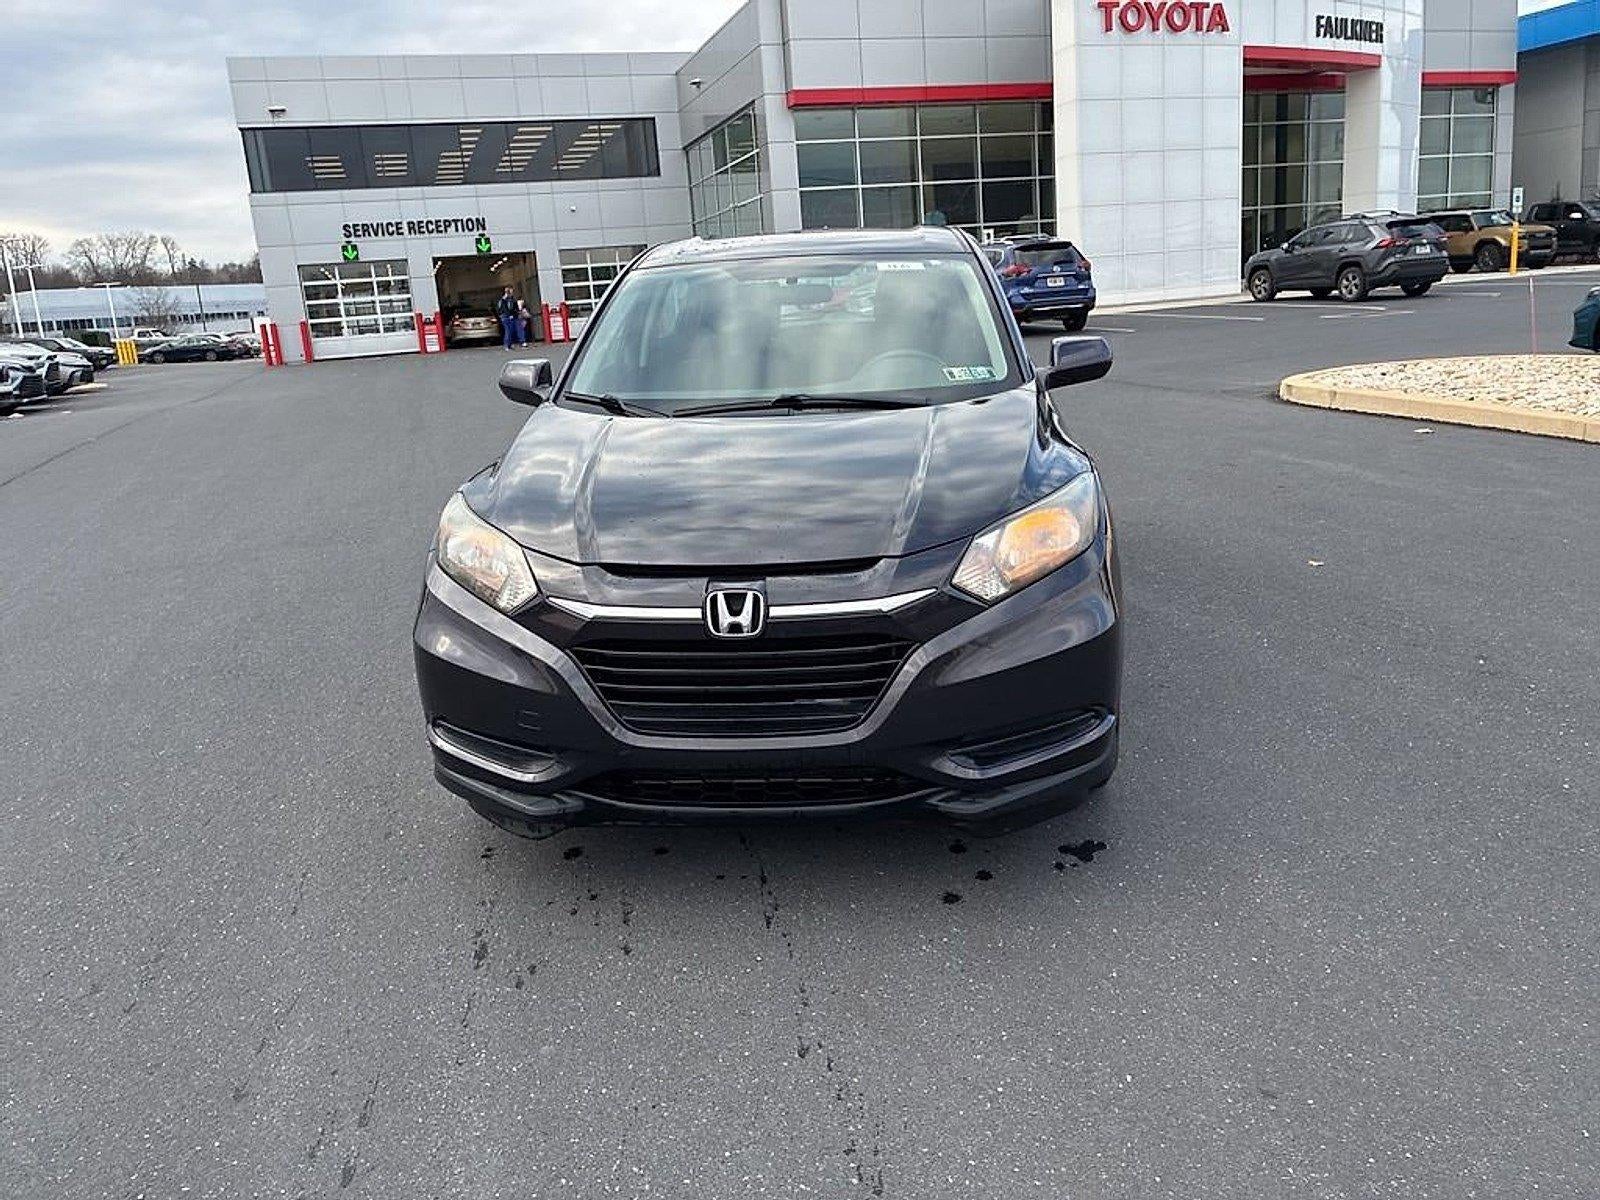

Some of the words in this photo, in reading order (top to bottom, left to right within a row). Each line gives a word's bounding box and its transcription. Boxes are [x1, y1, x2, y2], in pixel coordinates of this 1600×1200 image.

[1097, 1, 1230, 33] TOYOTA
[1315, 15, 1384, 43] FAULKNER
[342, 221, 404, 239] SERVICE
[407, 217, 486, 235] RECEPTION
